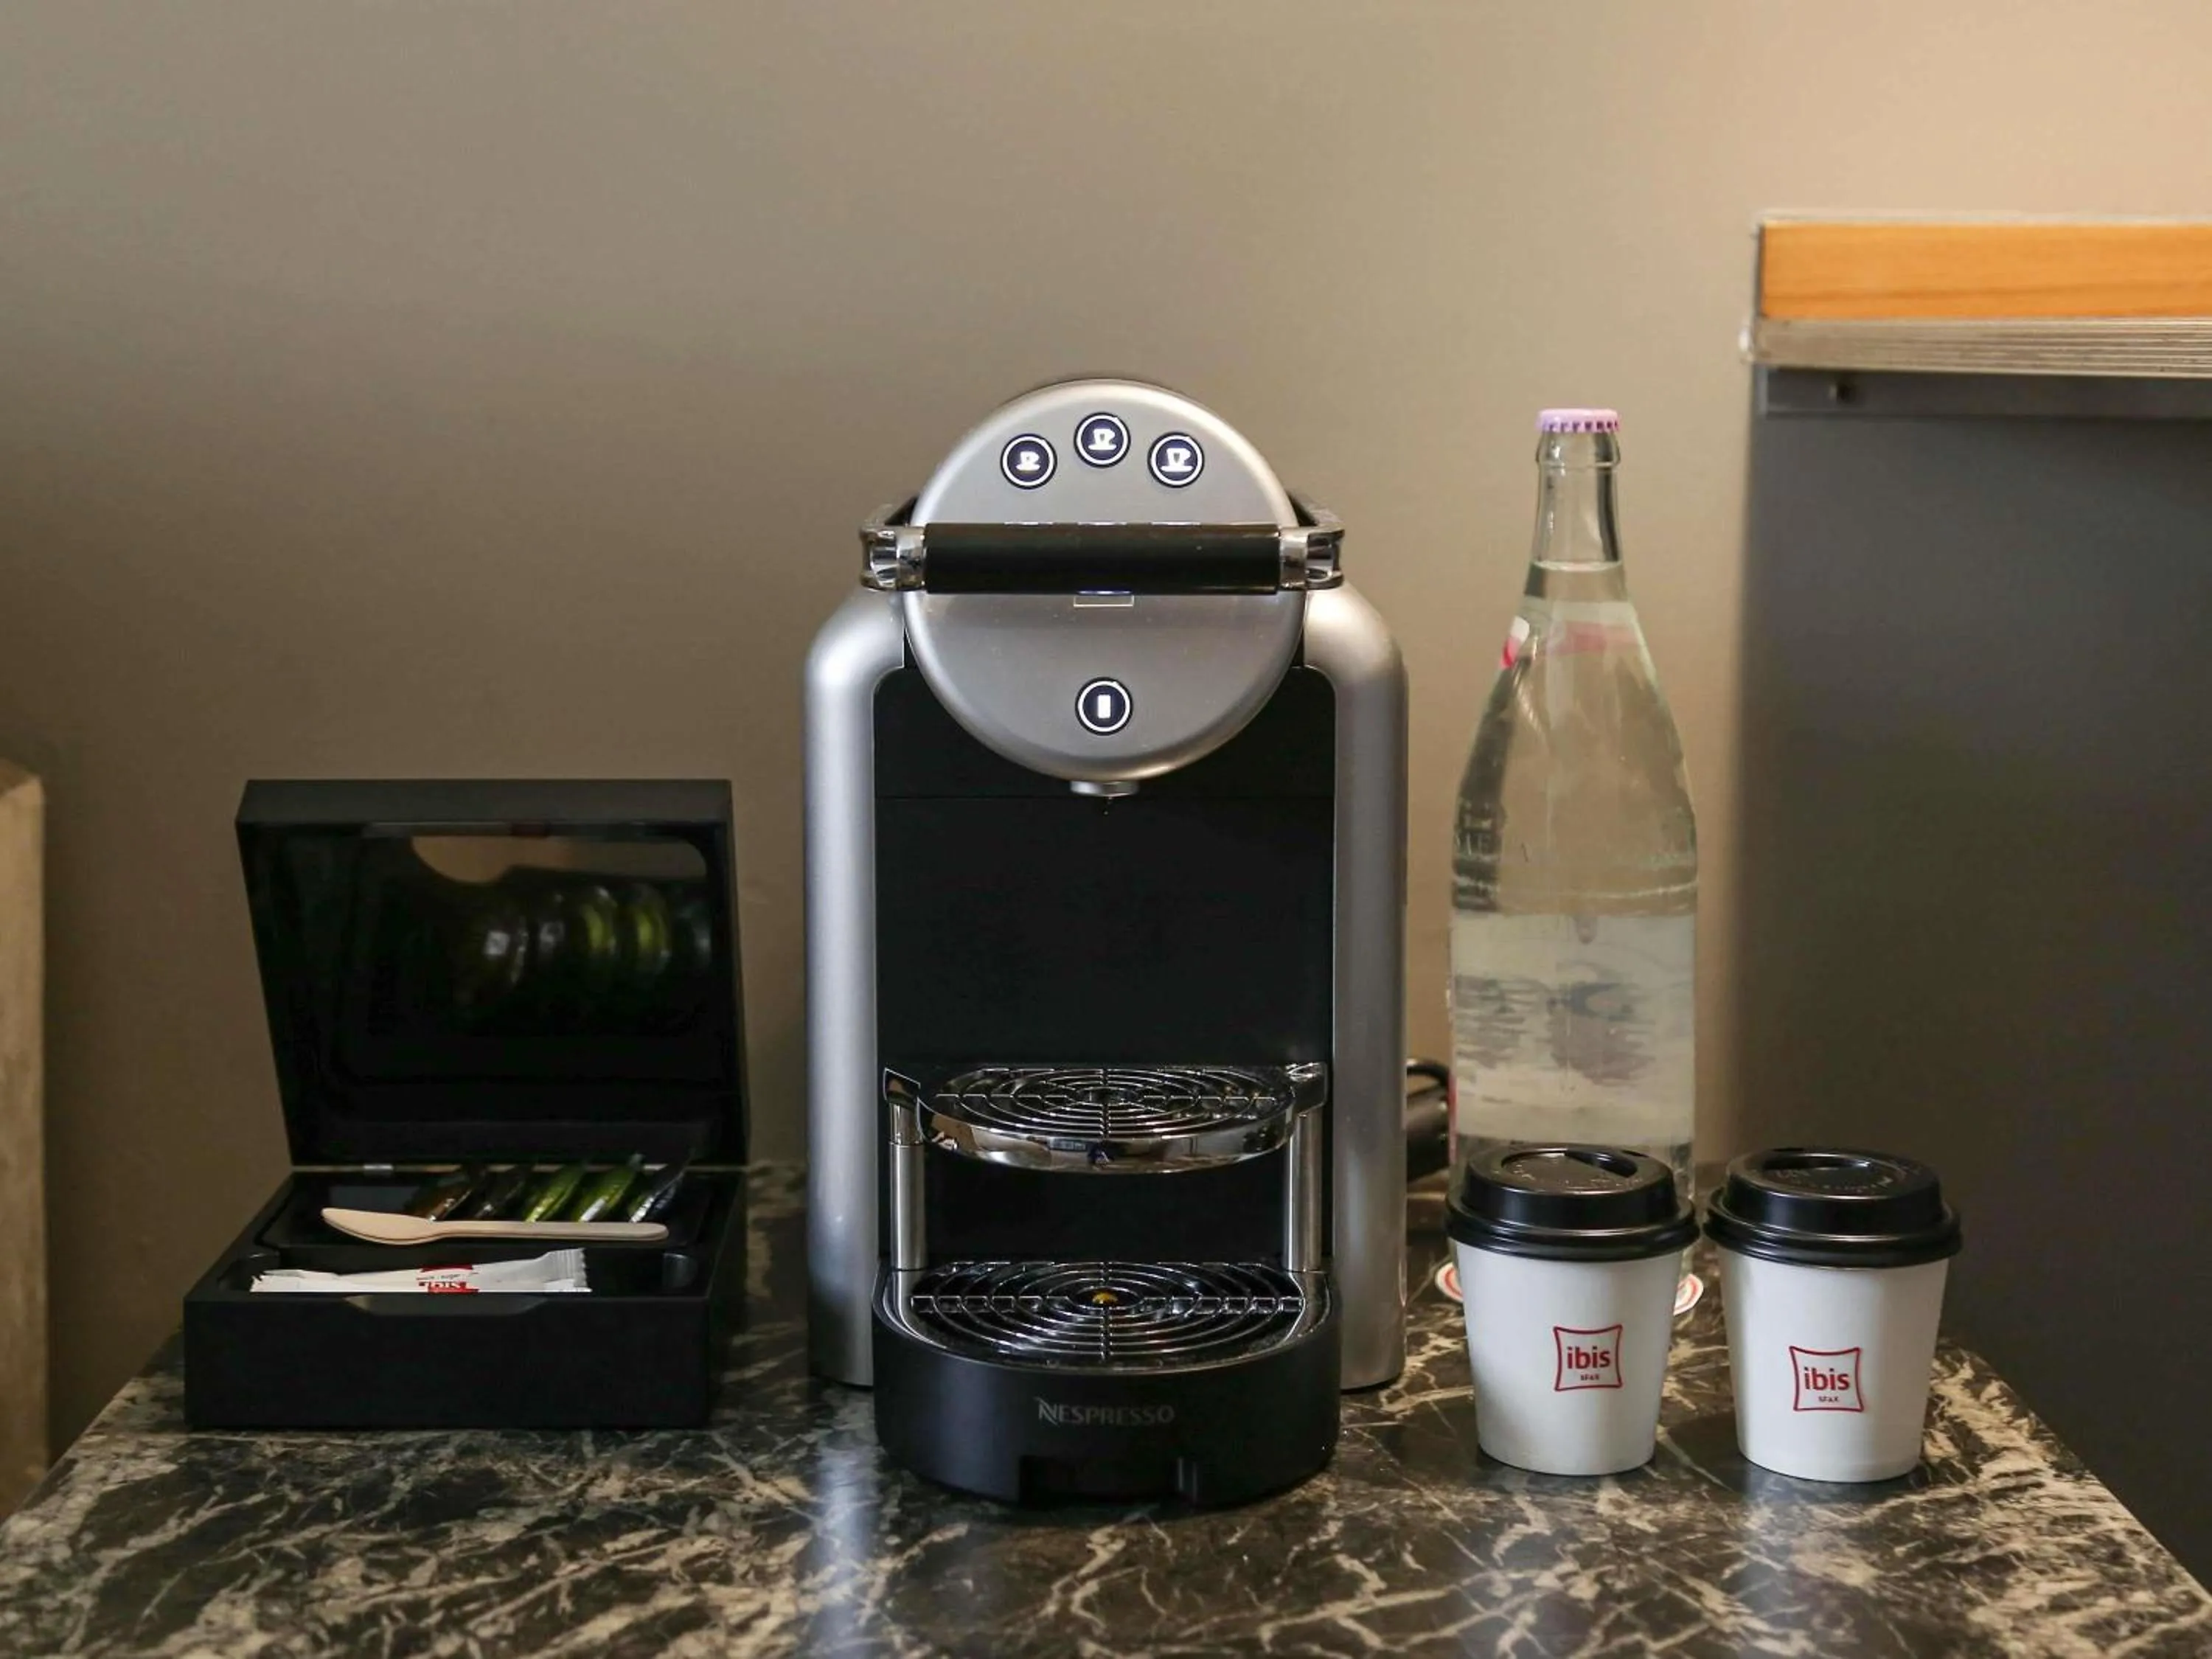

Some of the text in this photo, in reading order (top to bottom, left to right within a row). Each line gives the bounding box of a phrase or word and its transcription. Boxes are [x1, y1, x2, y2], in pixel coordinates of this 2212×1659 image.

[1567, 1345, 1611, 1369] ibis
[1804, 1366, 1851, 1391] ibis
[1034, 1397, 1175, 1427] NESPRESSO
